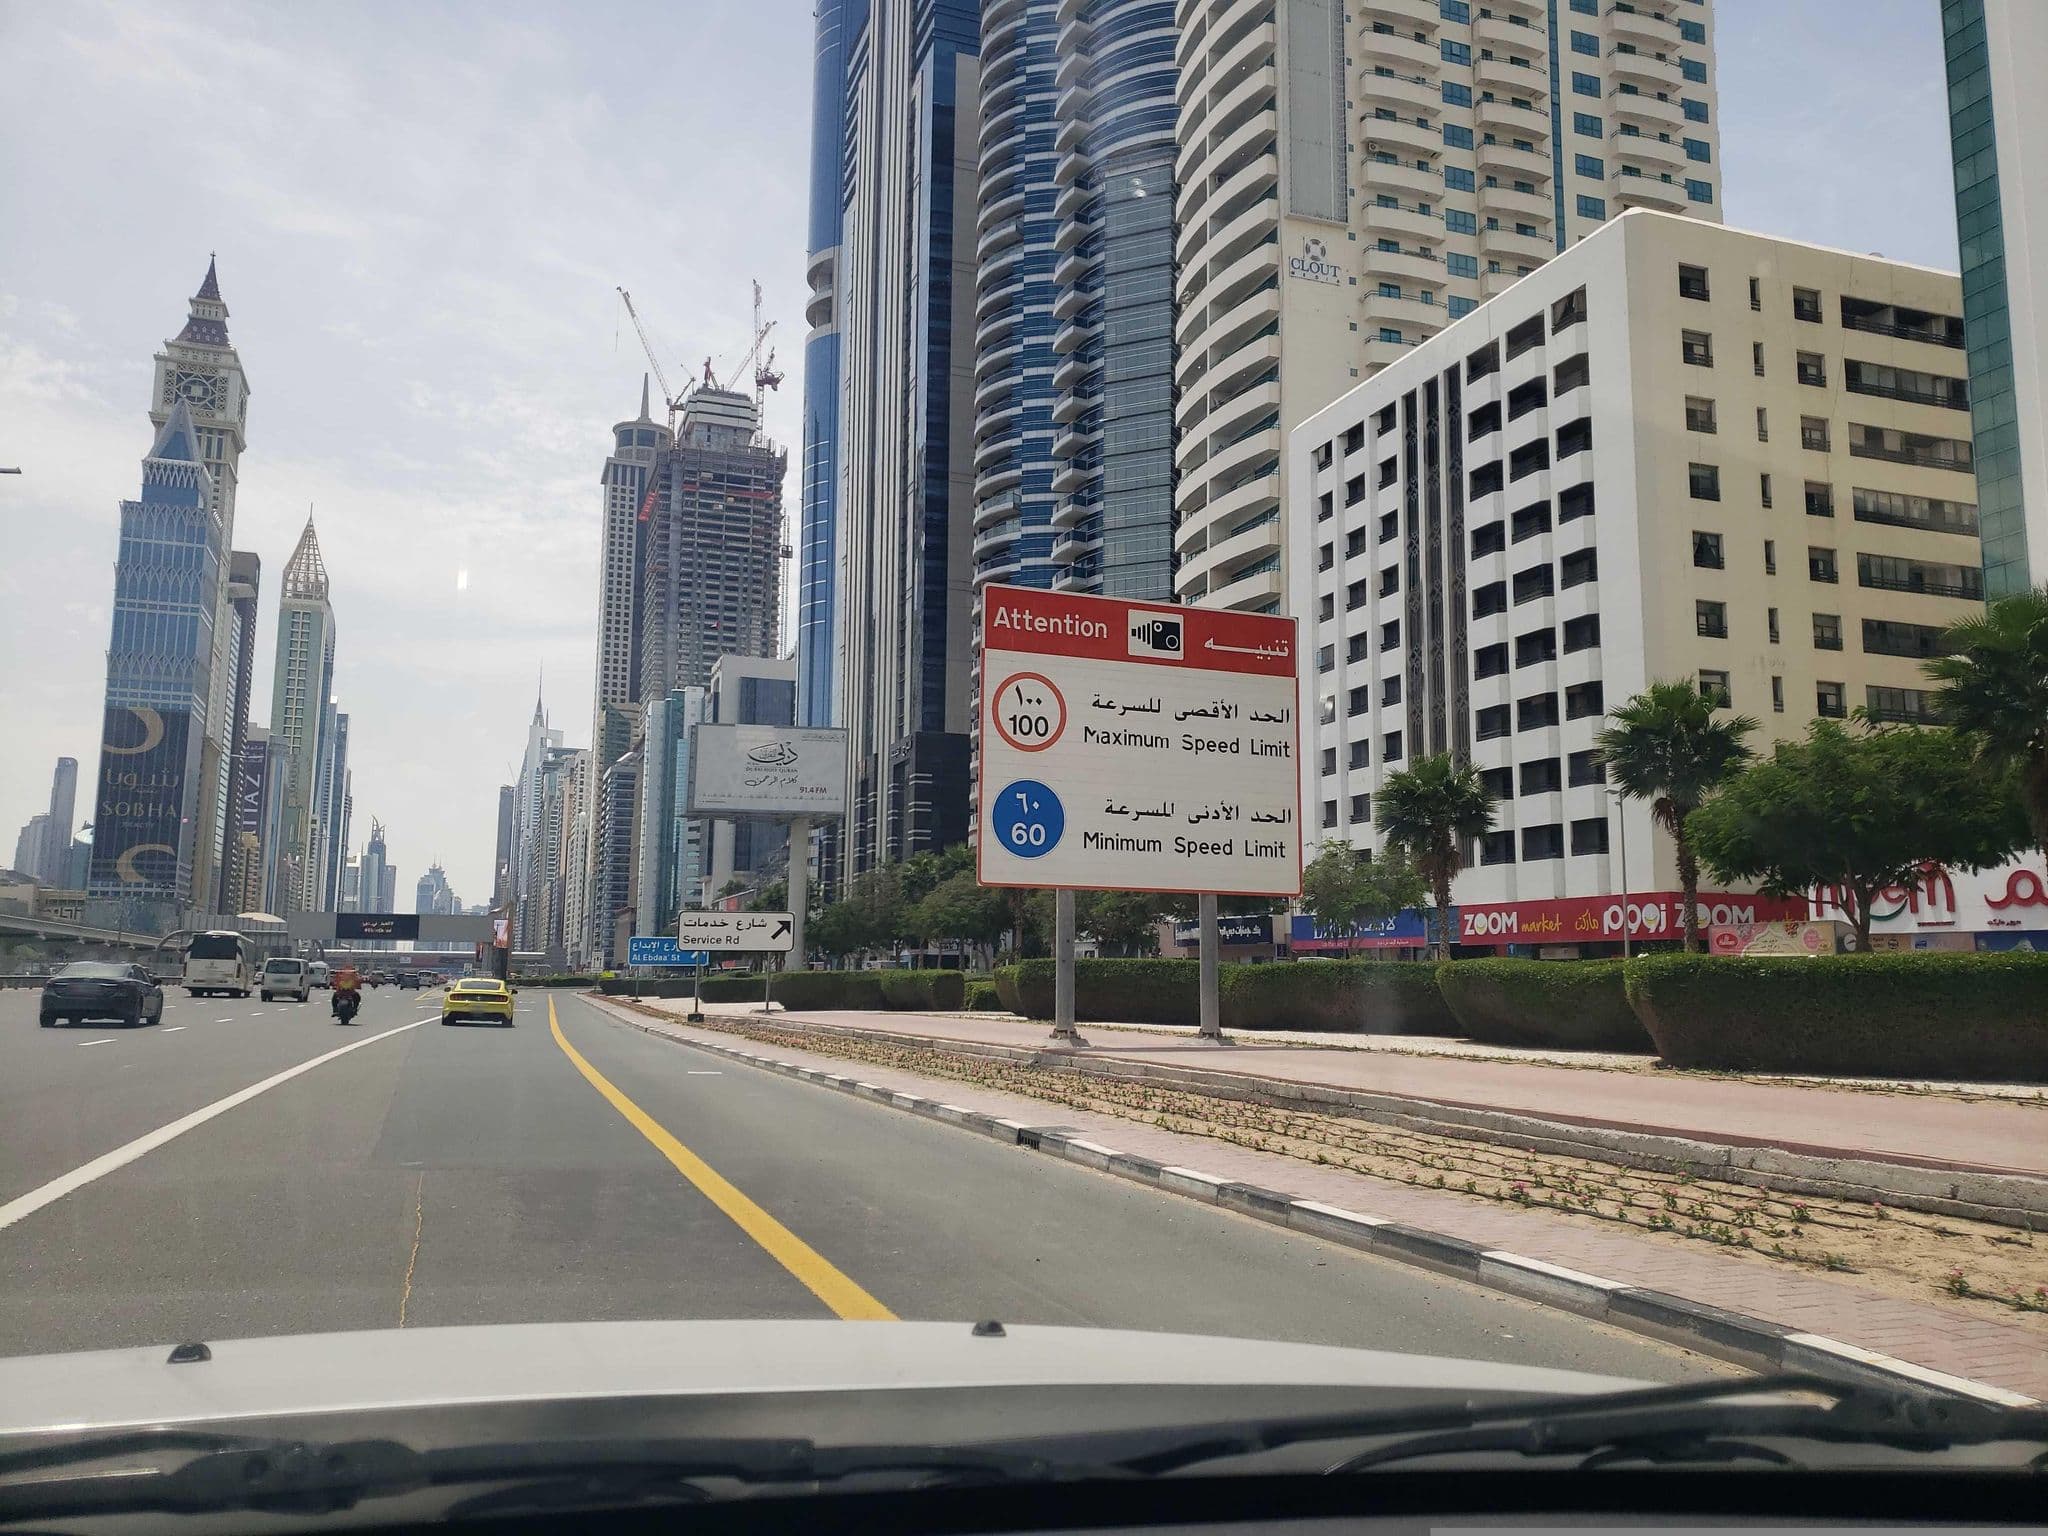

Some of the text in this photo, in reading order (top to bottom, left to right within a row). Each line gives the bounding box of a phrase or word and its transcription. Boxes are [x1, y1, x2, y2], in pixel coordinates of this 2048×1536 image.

[1291, 258, 1341, 278] CLOUT
[993, 606, 1108, 639] Attention
[1015, 685, 1042, 706] ١٠٠
[1091, 694, 1290, 724] الحد الأقصى للسرعة
[1008, 714, 1049, 737] 100
[1084, 726, 1290, 758] Maximum Speed Limit
[800, 786, 827, 794] 91.4 FM
[101, 801, 176, 817] SOBHA
[1015, 792, 1041, 815] ٦٠
[1187, 801, 1239, 824] الأدنى
[1250, 809, 1292, 824] الحد
[1011, 822, 1046, 846] 60
[1083, 832, 1286, 859] Minimum Speed Limit
[683, 917, 768, 931] شارع خدمات
[1464, 911, 1562, 936] ZOOM market
[1575, 908, 1599, 932] ماركت
[683, 935, 740, 945] Service Rd
[632, 953, 641, 961] Al
[671, 953, 680, 961] St
